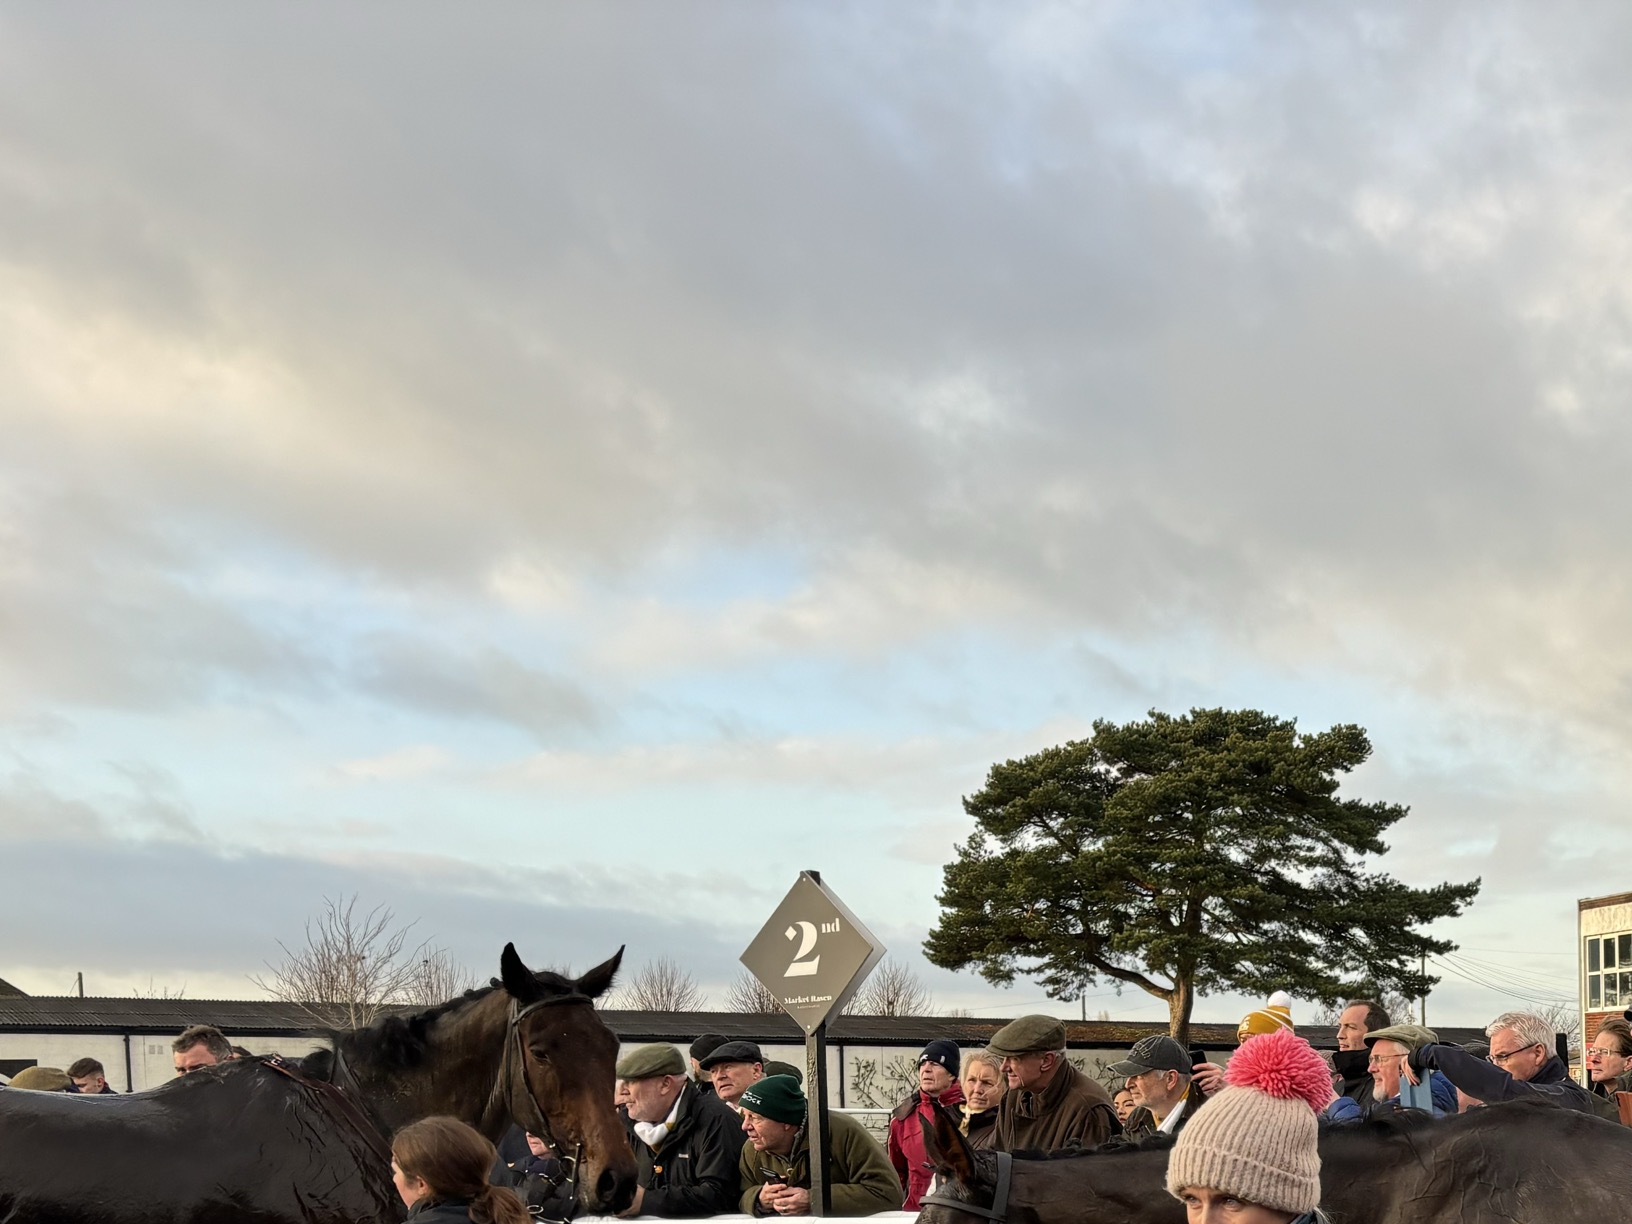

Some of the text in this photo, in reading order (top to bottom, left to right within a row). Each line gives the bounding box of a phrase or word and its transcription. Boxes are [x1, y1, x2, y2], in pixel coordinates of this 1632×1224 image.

[783, 917, 841, 977] 2nd
[784, 995, 833, 1005] Market Rasen
